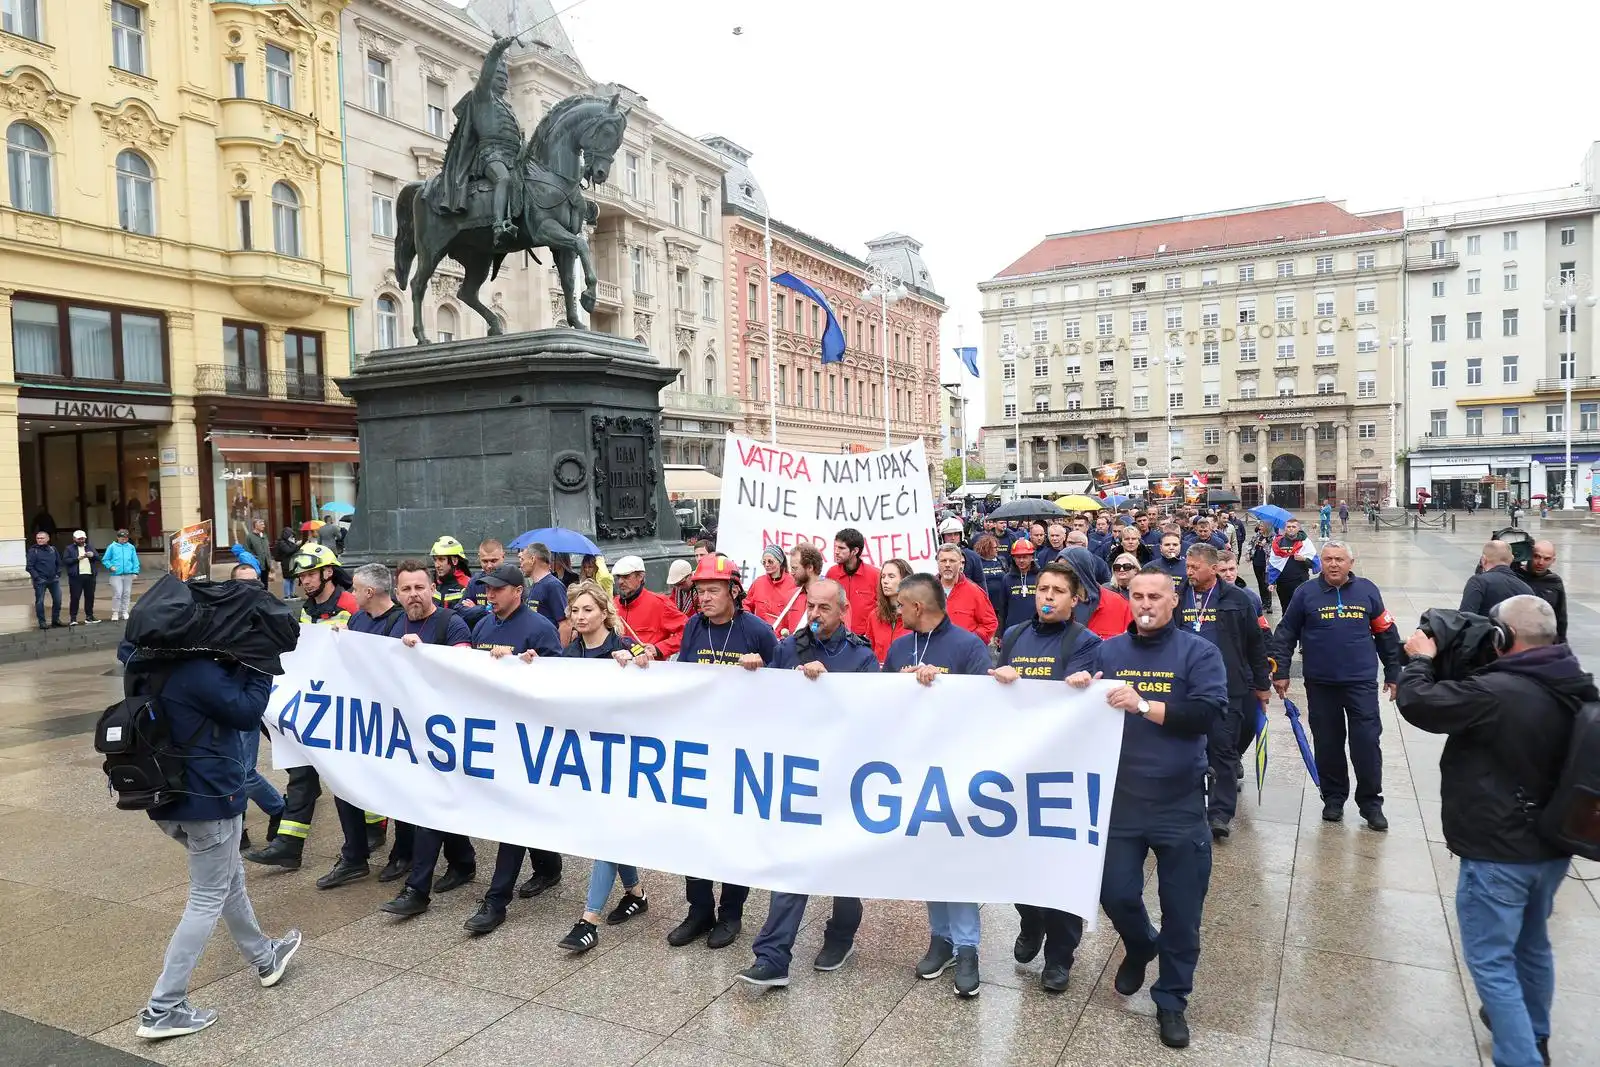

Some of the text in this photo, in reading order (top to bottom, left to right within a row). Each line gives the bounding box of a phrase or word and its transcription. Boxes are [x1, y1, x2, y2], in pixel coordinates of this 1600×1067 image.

[1017, 337, 1130, 359] RADSKA
[55, 401, 137, 419] HARMICA
[736, 439, 919, 483] VATRA NAM IPAK
[738, 477, 918, 522] NIJE NAJVEĆI
[1025, 666, 1052, 676] GASE
[1152, 671, 1175, 679] VATRE
[1138, 681, 1172, 693] GASE
[270, 680, 1101, 847] AŽIMA SE VATRE NE GASE!
